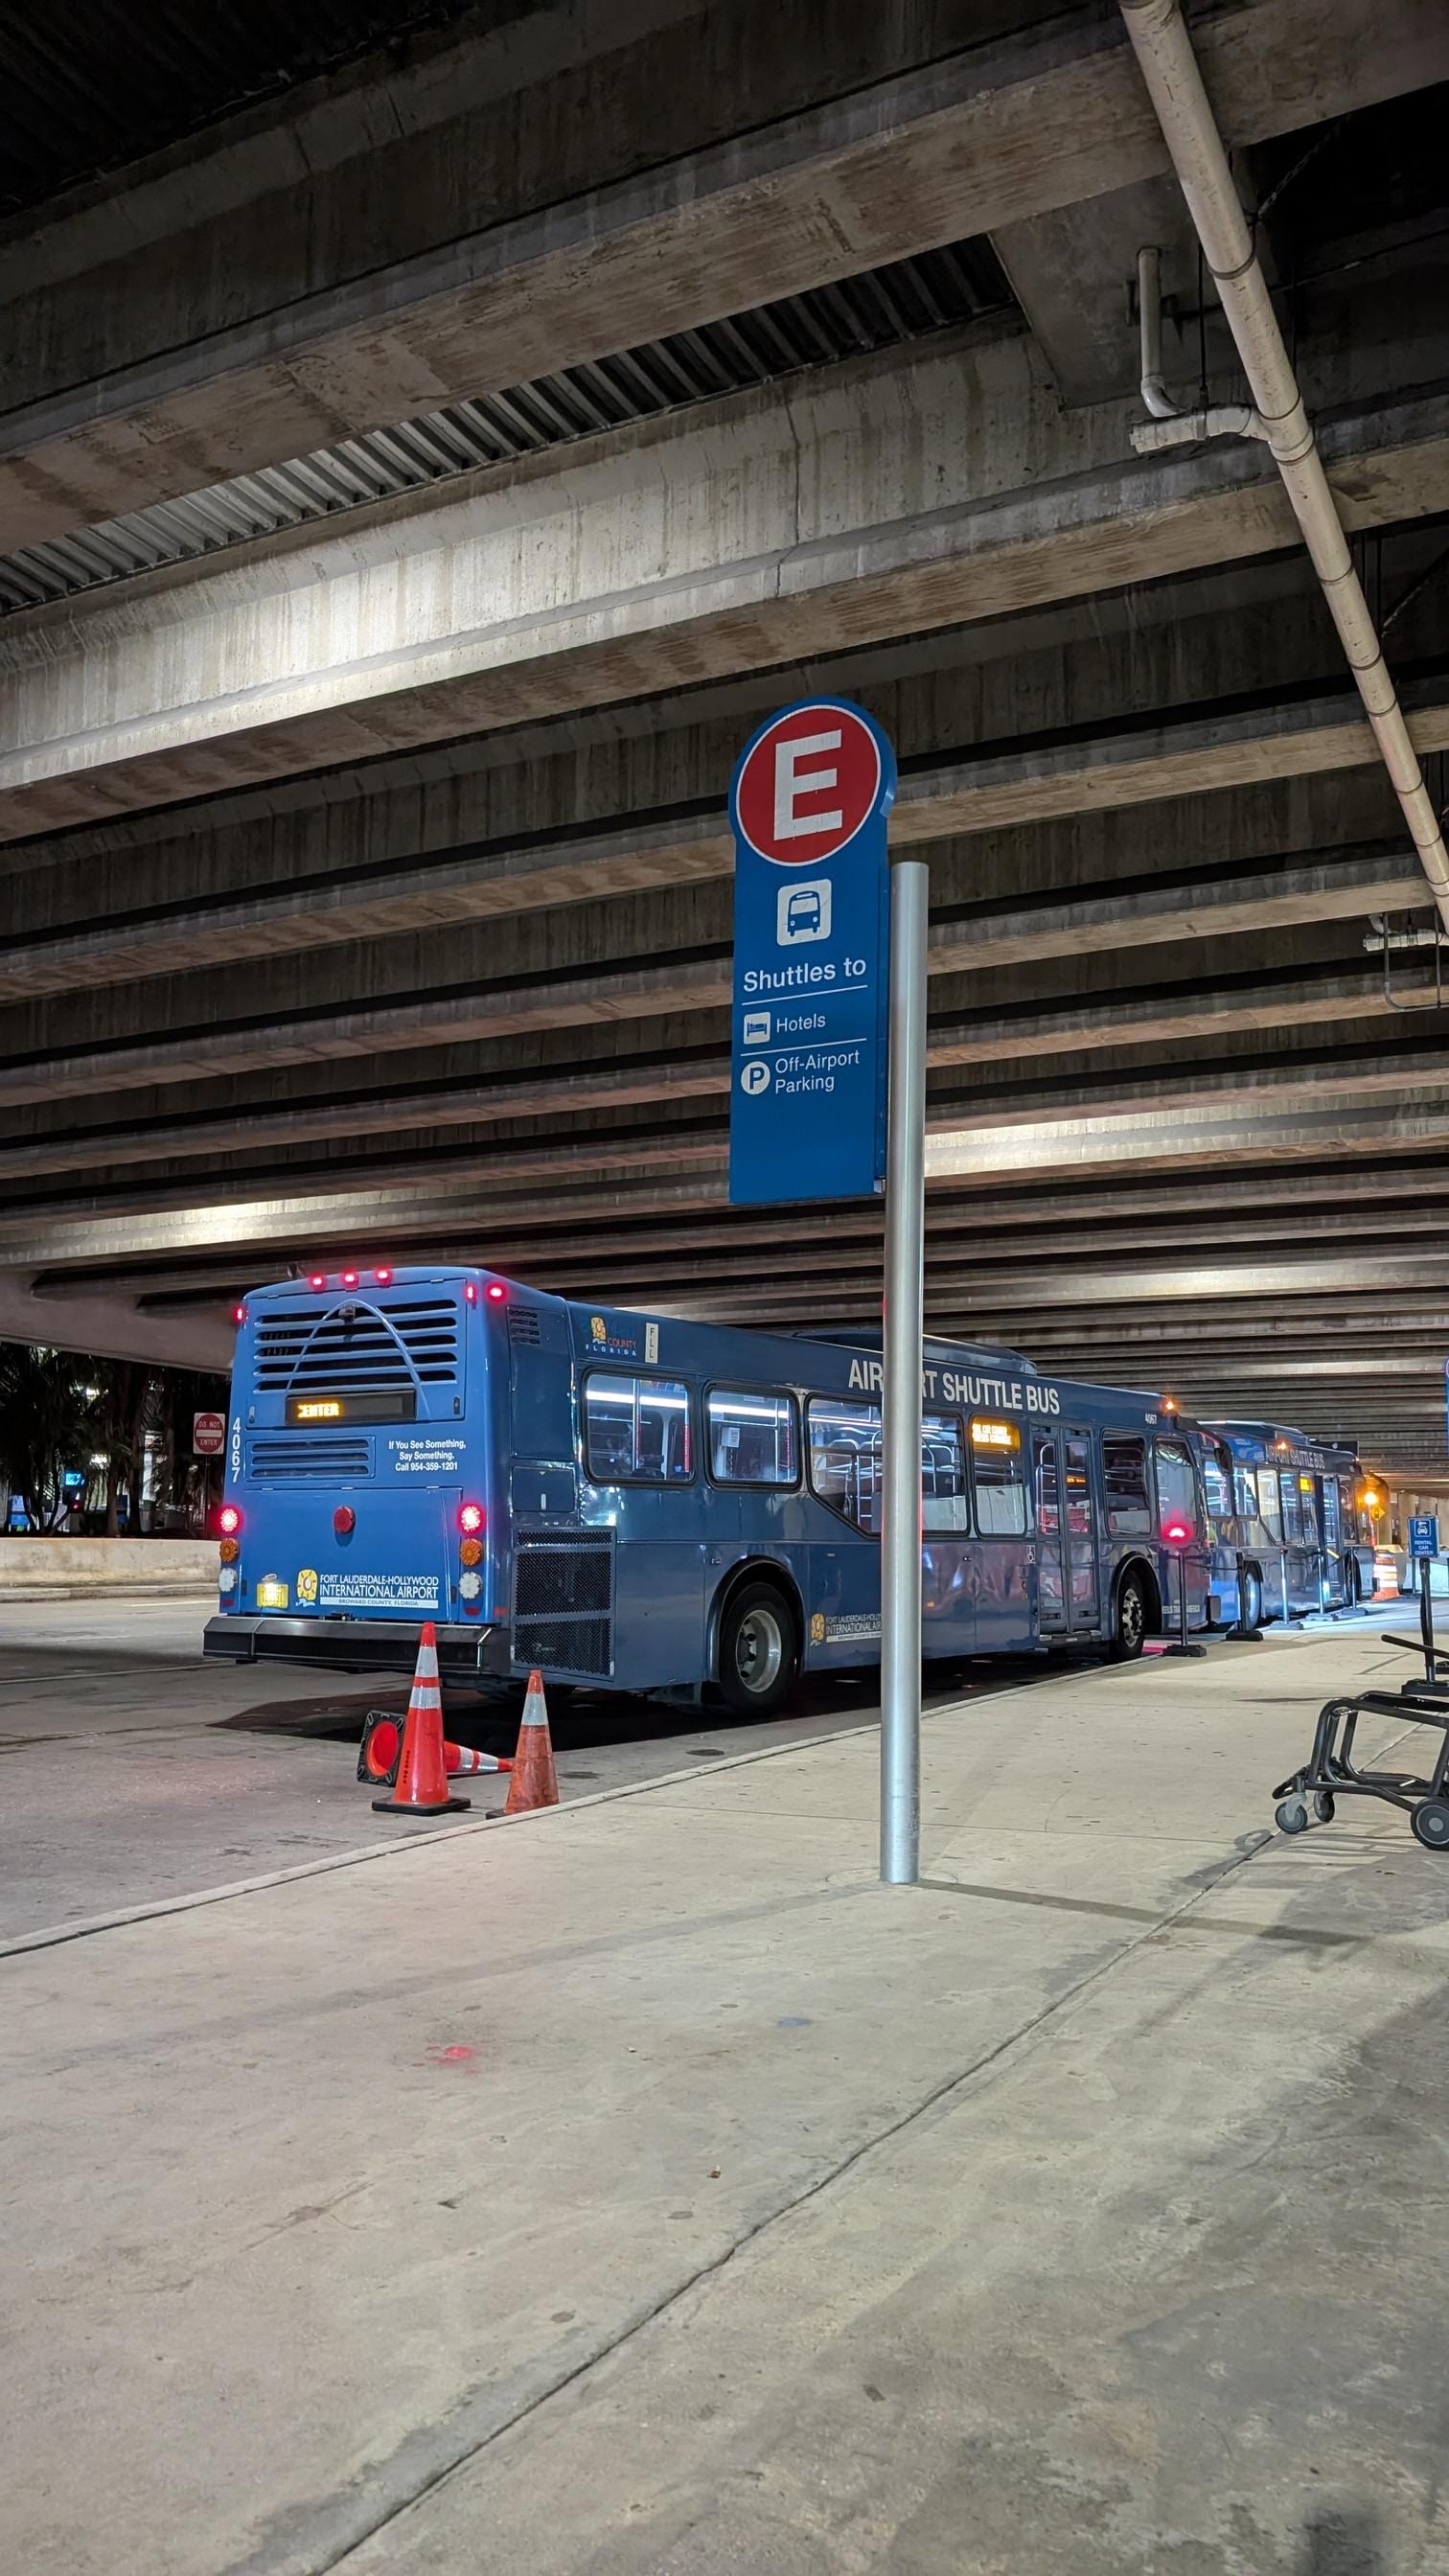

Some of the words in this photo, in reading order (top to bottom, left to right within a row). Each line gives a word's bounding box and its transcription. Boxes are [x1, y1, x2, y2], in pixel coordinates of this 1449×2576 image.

[774, 729, 842, 840] E
[744, 963, 836, 992] Shuttles
[843, 957, 866, 978] to
[776, 1013, 826, 1033] Hotels
[775, 1050, 860, 1074] Off-Airport
[748, 1067, 766, 1090] P
[775, 1075, 835, 1094] Parking
[586, 1344, 637, 1357] FLORIDA
[608, 1337, 636, 1349] COUNTY
[848, 1359, 937, 1399] AIRT
[942, 1372, 1023, 1410] SHUTTLE
[1026, 1386, 1060, 1414] BUS
[209, 1420, 220, 1429] NOT
[232, 1417, 241, 1484] 4067
[388, 1440, 395, 1449] If
[395, 1440, 409, 1449] You
[409, 1439, 425, 1449] See
[425, 1438, 467, 1449] Something,
[399, 1451, 413, 1461] Say
[414, 1450, 455, 1460] Something.
[1313, 1452, 1325, 1469] BUS
[395, 1462, 410, 1471] Call
[410, 1461, 458, 1471] 954-359-1201
[320, 1575, 338, 1584] FORT
[339, 1575, 439, 1586] LAUDERDALE-HOLLYWOOD
[320, 1584, 395, 1598] INTERNATIONAL
[396, 1586, 439, 1599] AIRPORT
[826, 1620, 872, 1635] INTERNATIONAL
